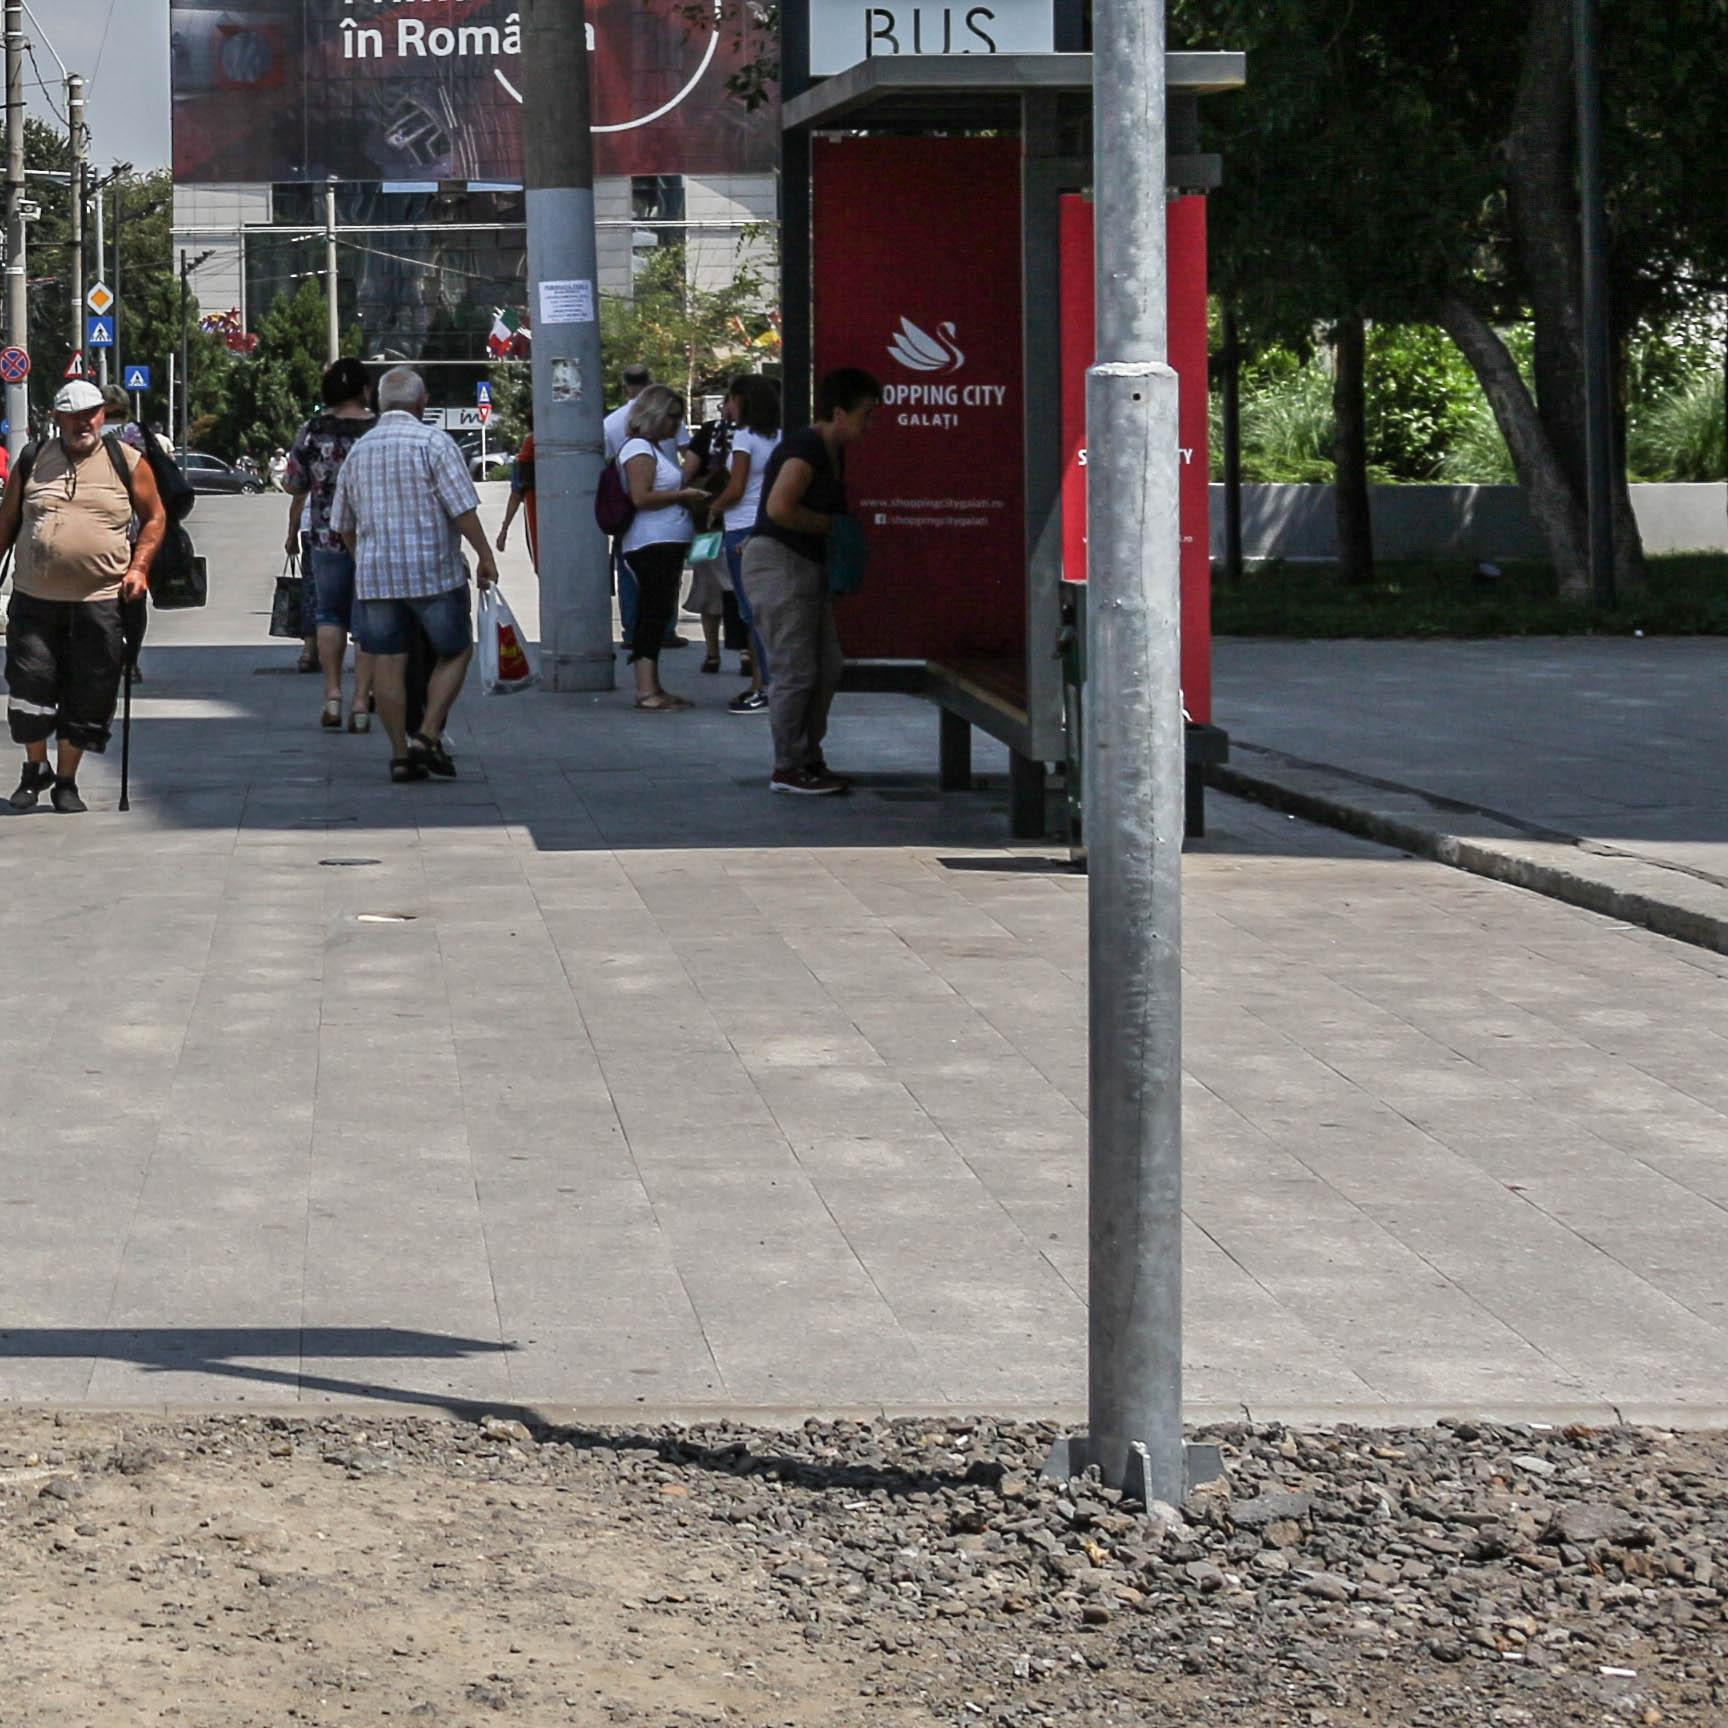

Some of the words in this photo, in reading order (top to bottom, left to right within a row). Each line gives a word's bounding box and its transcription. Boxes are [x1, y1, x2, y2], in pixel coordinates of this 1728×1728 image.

[340, 18, 383, 58] în
[865, 7, 995, 58] BUS
[882, 384, 959, 406] OPPING
[962, 384, 1007, 406] CITY
